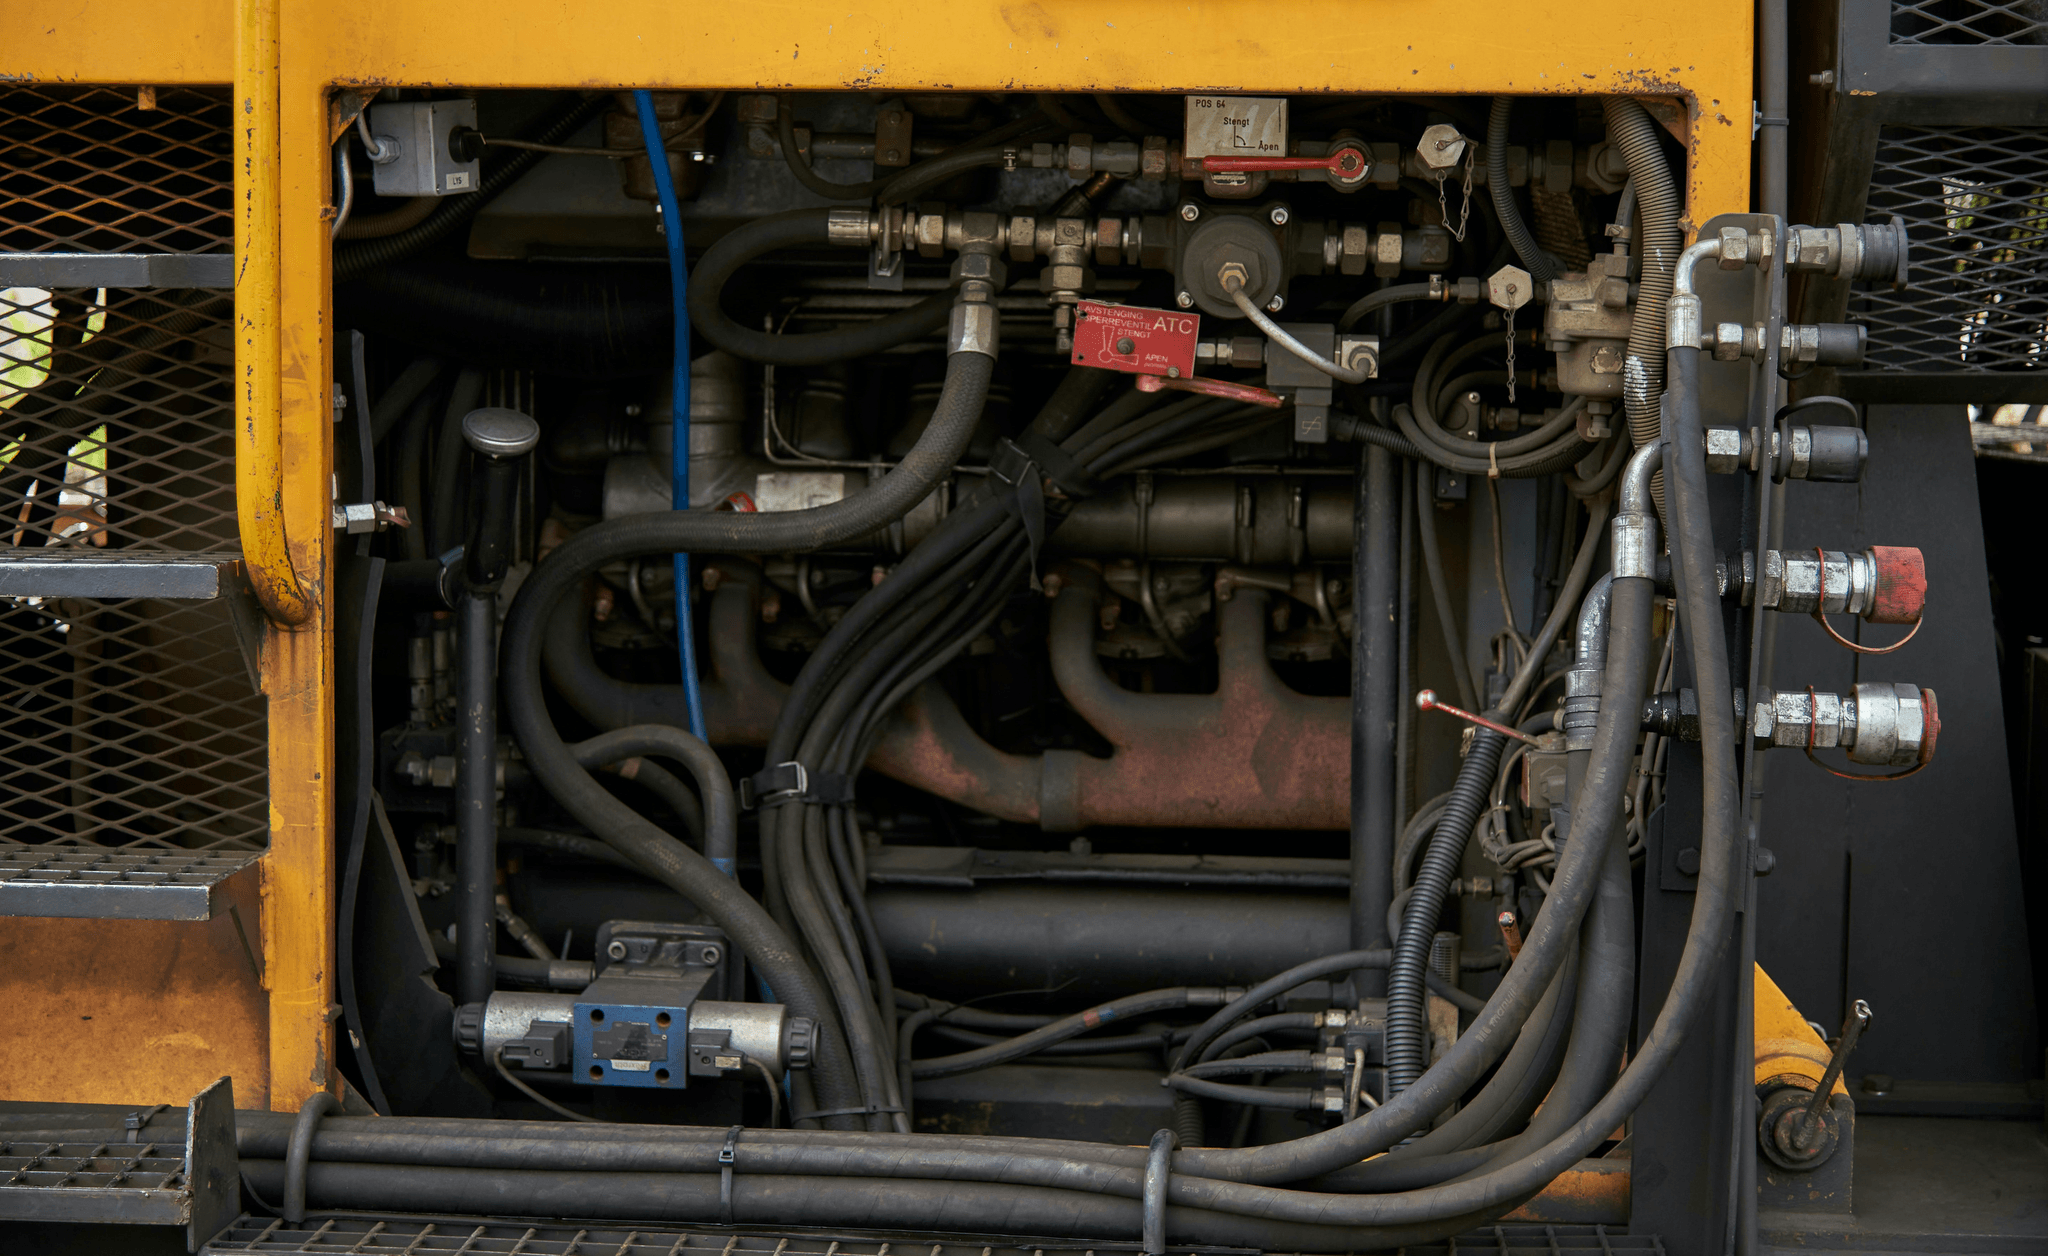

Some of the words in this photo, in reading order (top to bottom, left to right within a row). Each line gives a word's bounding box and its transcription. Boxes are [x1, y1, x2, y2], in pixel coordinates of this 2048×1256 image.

[1195, 99, 1212, 108] POS
[1216, 100, 1226, 108] 64
[1223, 117, 1250, 127] Stengt
[1258, 140, 1279, 152] Åpen
[453, 176, 462, 185] LYS
[1084, 305, 1144, 320] AVSTENGING
[1086, 315, 1152, 331] SPERREVENTIL
[1153, 316, 1193, 335] ATC
[1117, 328, 1151, 339] STENGT
